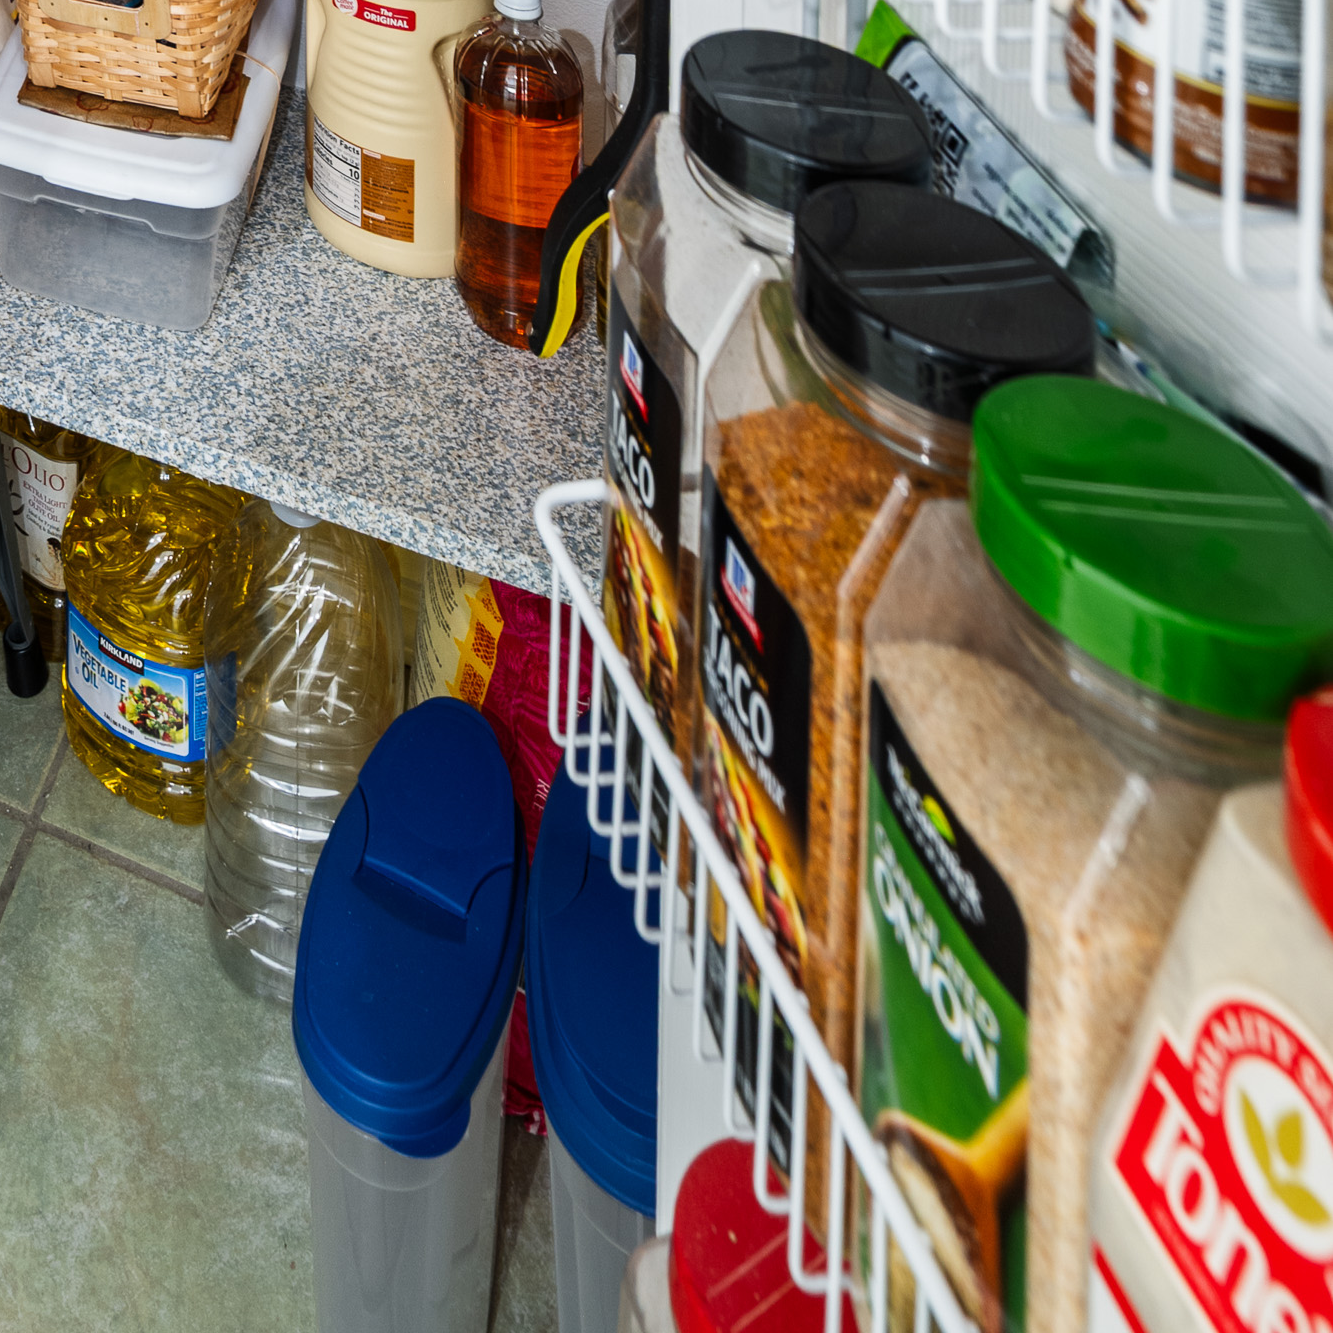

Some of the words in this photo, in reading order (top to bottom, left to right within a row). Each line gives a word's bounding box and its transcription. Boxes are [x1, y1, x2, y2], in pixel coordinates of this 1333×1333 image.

[363, 13, 410, 31] ORIGINAL
[22, 480, 43, 501] EXTRA
[42, 493, 67, 511] LIGHT
[27, 498, 46, 517] OLIVE
[46, 511, 61, 523] OIL
[71, 632, 127, 694] VEGETABLE
[99, 637, 144, 669] KIRKLAND
[81, 666, 100, 690] OIL
[707, 602, 776, 757] TACO
